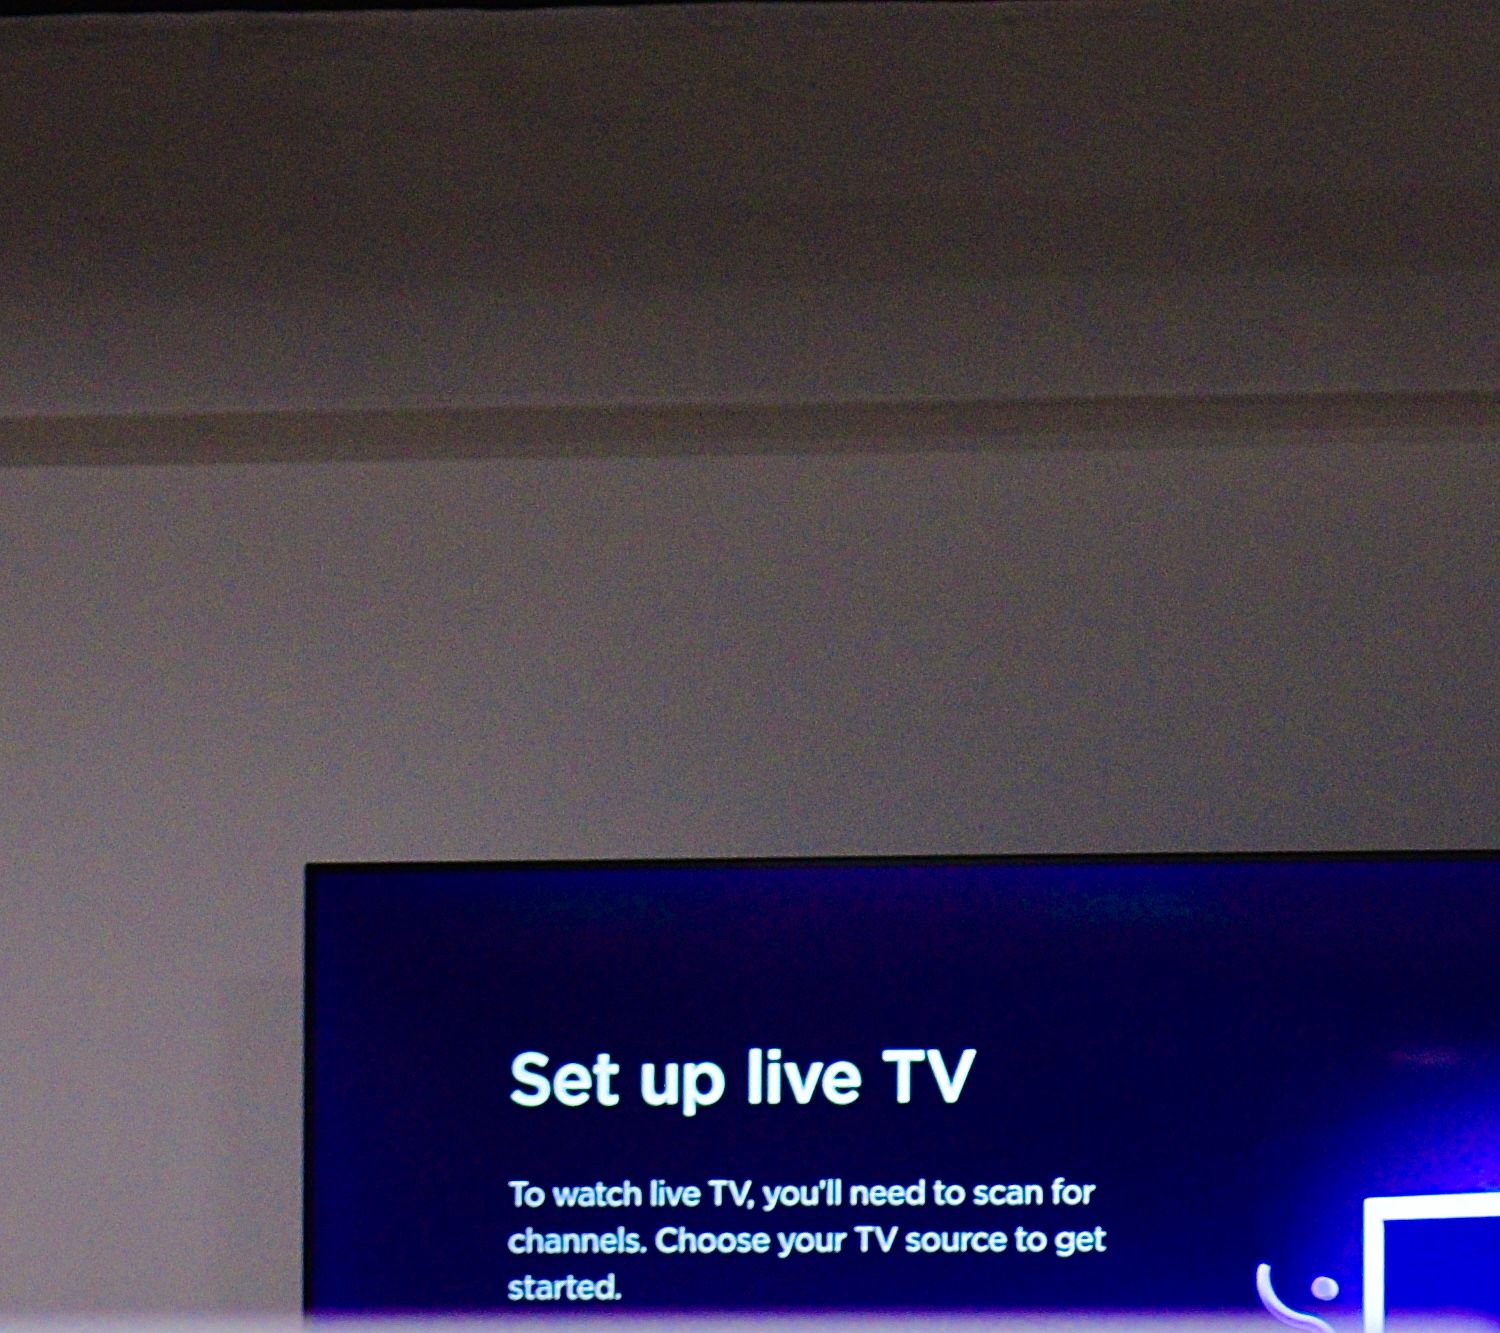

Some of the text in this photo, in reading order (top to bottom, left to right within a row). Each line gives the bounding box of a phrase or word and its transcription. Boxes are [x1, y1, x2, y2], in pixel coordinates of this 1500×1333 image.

[509, 1048, 977, 1117] Set up live TV
[508, 1177, 1097, 1212] To watch live TV, you'll need to scan for
[507, 1226, 1107, 1259] channels. Choose your TV source to get
[508, 1272, 622, 1301] started.
